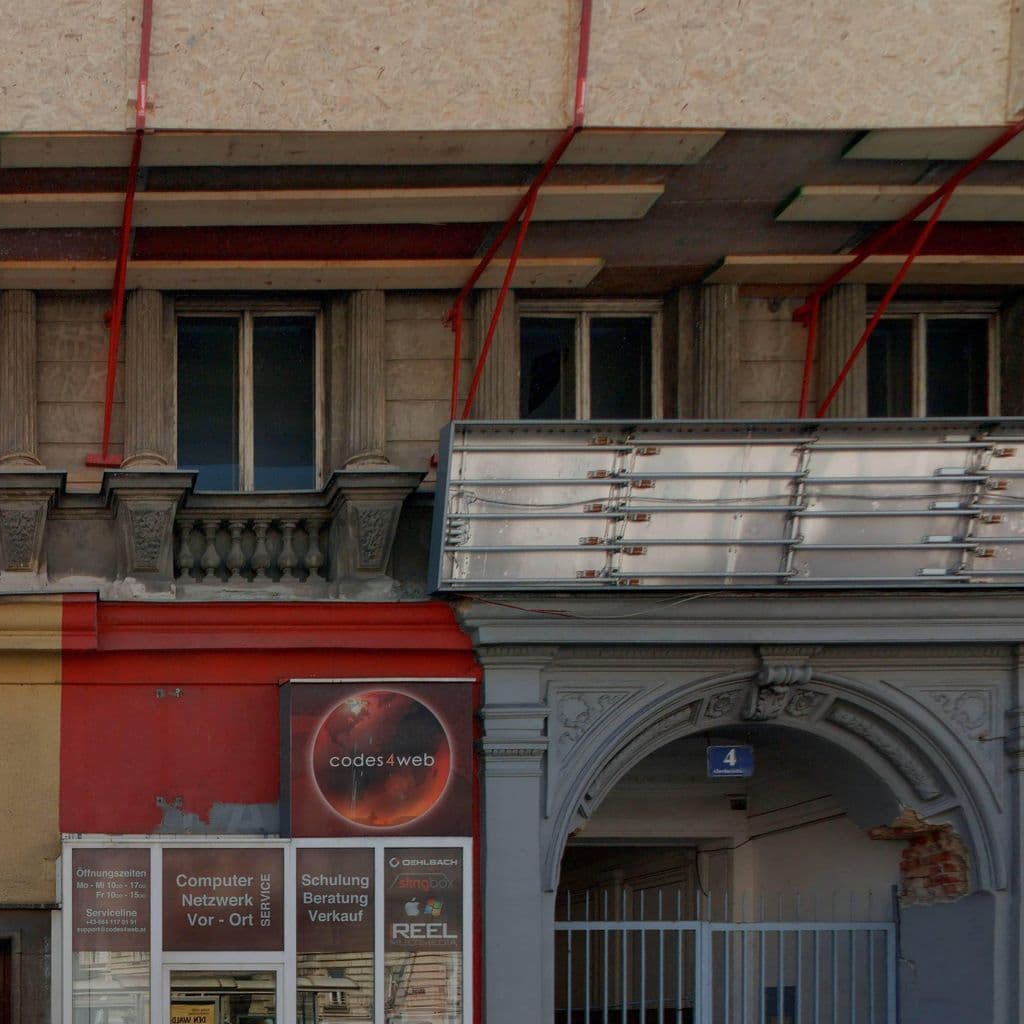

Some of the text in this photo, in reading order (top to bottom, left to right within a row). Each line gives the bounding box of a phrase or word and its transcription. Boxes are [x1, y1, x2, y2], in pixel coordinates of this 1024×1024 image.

[328, 753, 435, 768] codes4web
[722, 748, 737, 766] 4
[402, 858, 458, 866] OEHLBACH
[75, 867, 147, 879] Öffnungszeiten
[76, 881, 89, 889] Mo
[175, 873, 254, 890] Computer
[301, 873, 370, 889] Schulung
[181, 893, 254, 907] Netzwerk
[260, 873, 271, 927] SERVICE
[303, 892, 369, 907] Beratung
[86, 908, 138, 917] Serviceline
[187, 912, 215, 926] Vor
[228, 912, 254, 926] Ort
[308, 909, 364, 922] Verkauf
[392, 922, 458, 939] REEL
